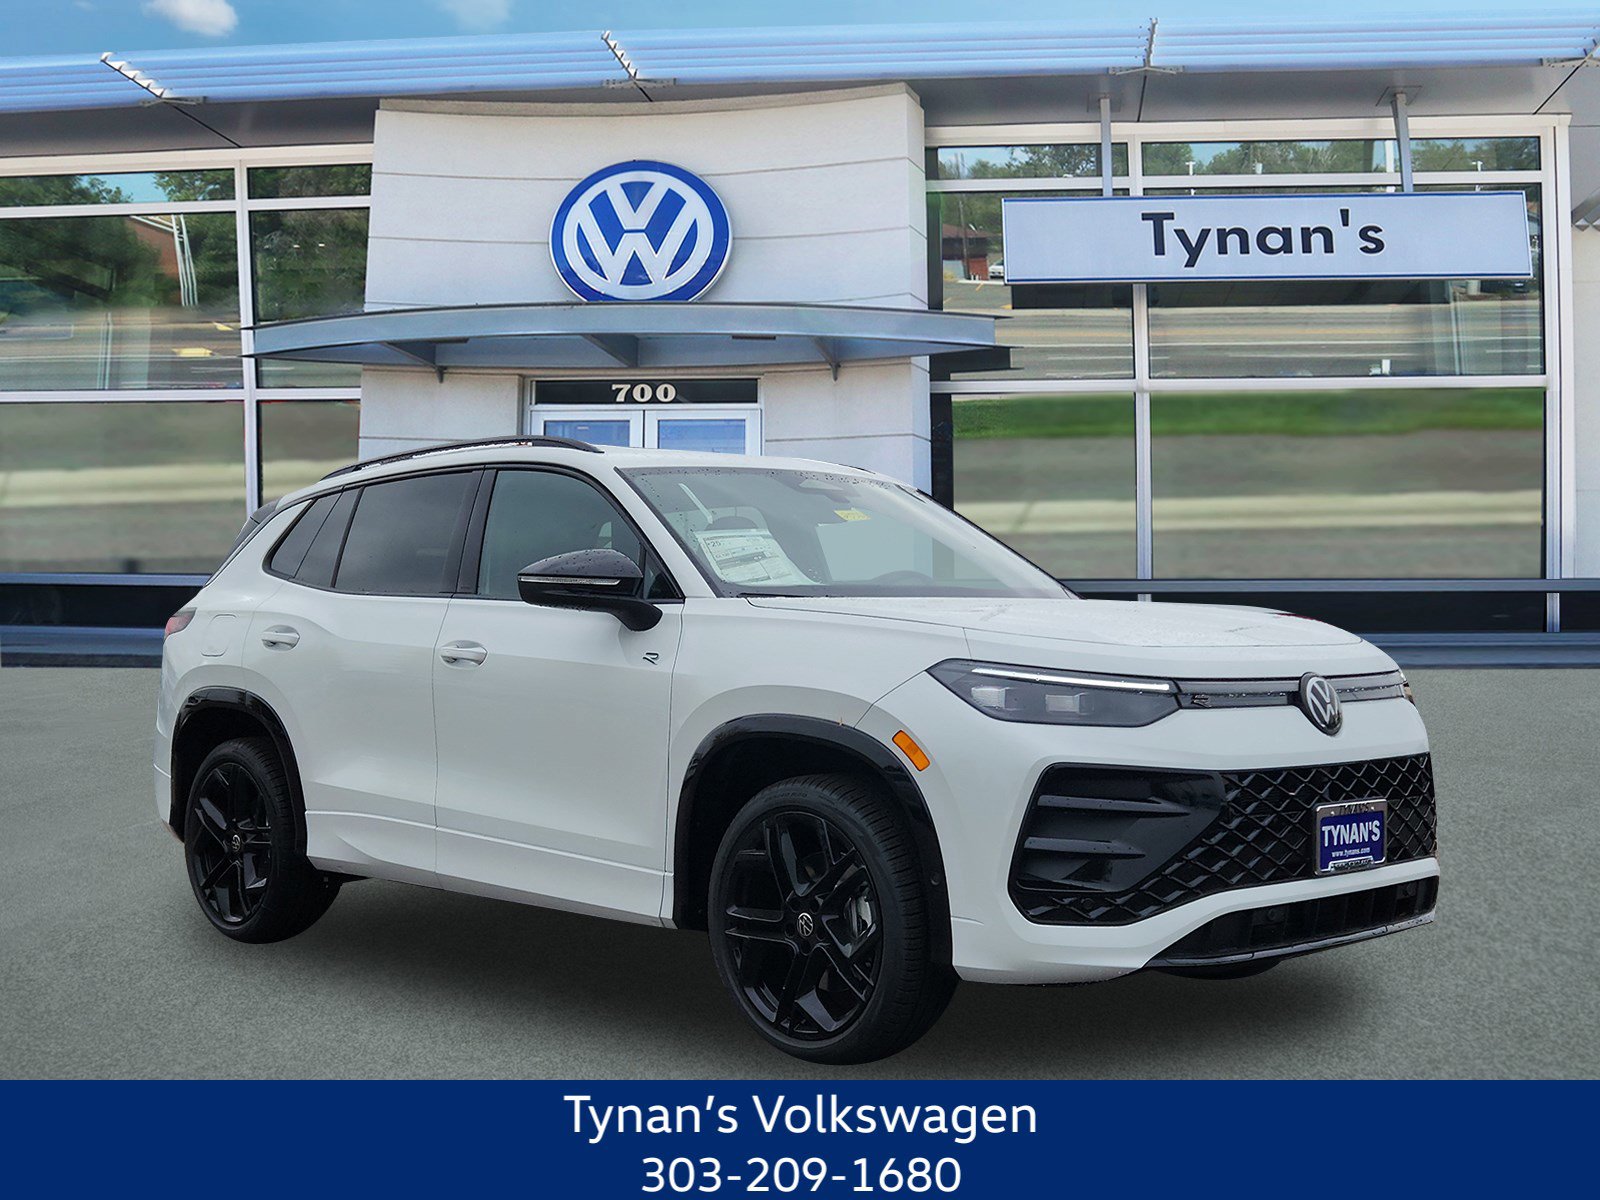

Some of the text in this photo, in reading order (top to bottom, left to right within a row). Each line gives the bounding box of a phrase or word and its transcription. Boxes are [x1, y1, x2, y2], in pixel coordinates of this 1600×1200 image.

[563, 170, 714, 300] VW
[1141, 207, 1385, 268] Tynan's
[611, 383, 676, 403] 700
[1321, 820, 1381, 848] TYNAN'S
